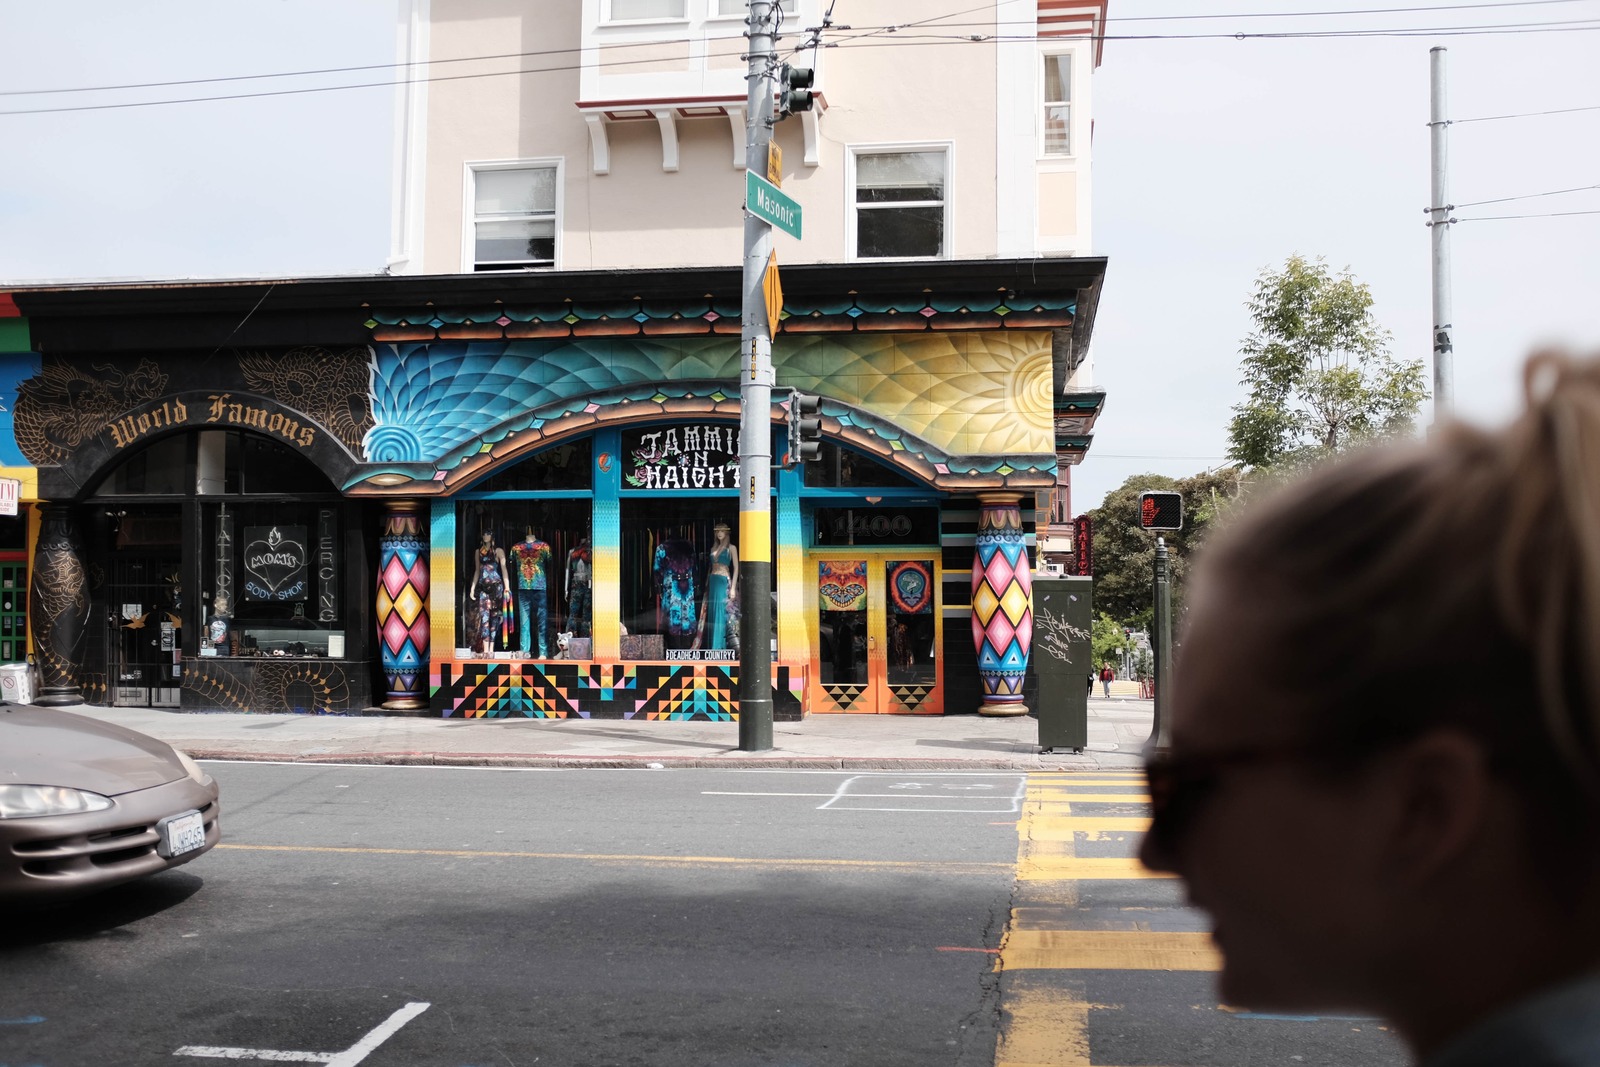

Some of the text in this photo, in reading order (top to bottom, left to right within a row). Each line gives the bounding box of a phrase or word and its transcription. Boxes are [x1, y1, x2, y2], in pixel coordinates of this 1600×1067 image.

[757, 186, 794, 228] Masonic
[107, 393, 316, 448] World Famous
[640, 426, 740, 459] JAMMI
[833, 514, 912, 537] 1400
[251, 553, 297, 568] MOM'S
[320, 510, 335, 621] PIERCING
[245, 581, 304, 600] BODY SHOP
[669, 651, 731, 661] DEADHEAD COUNTRY
